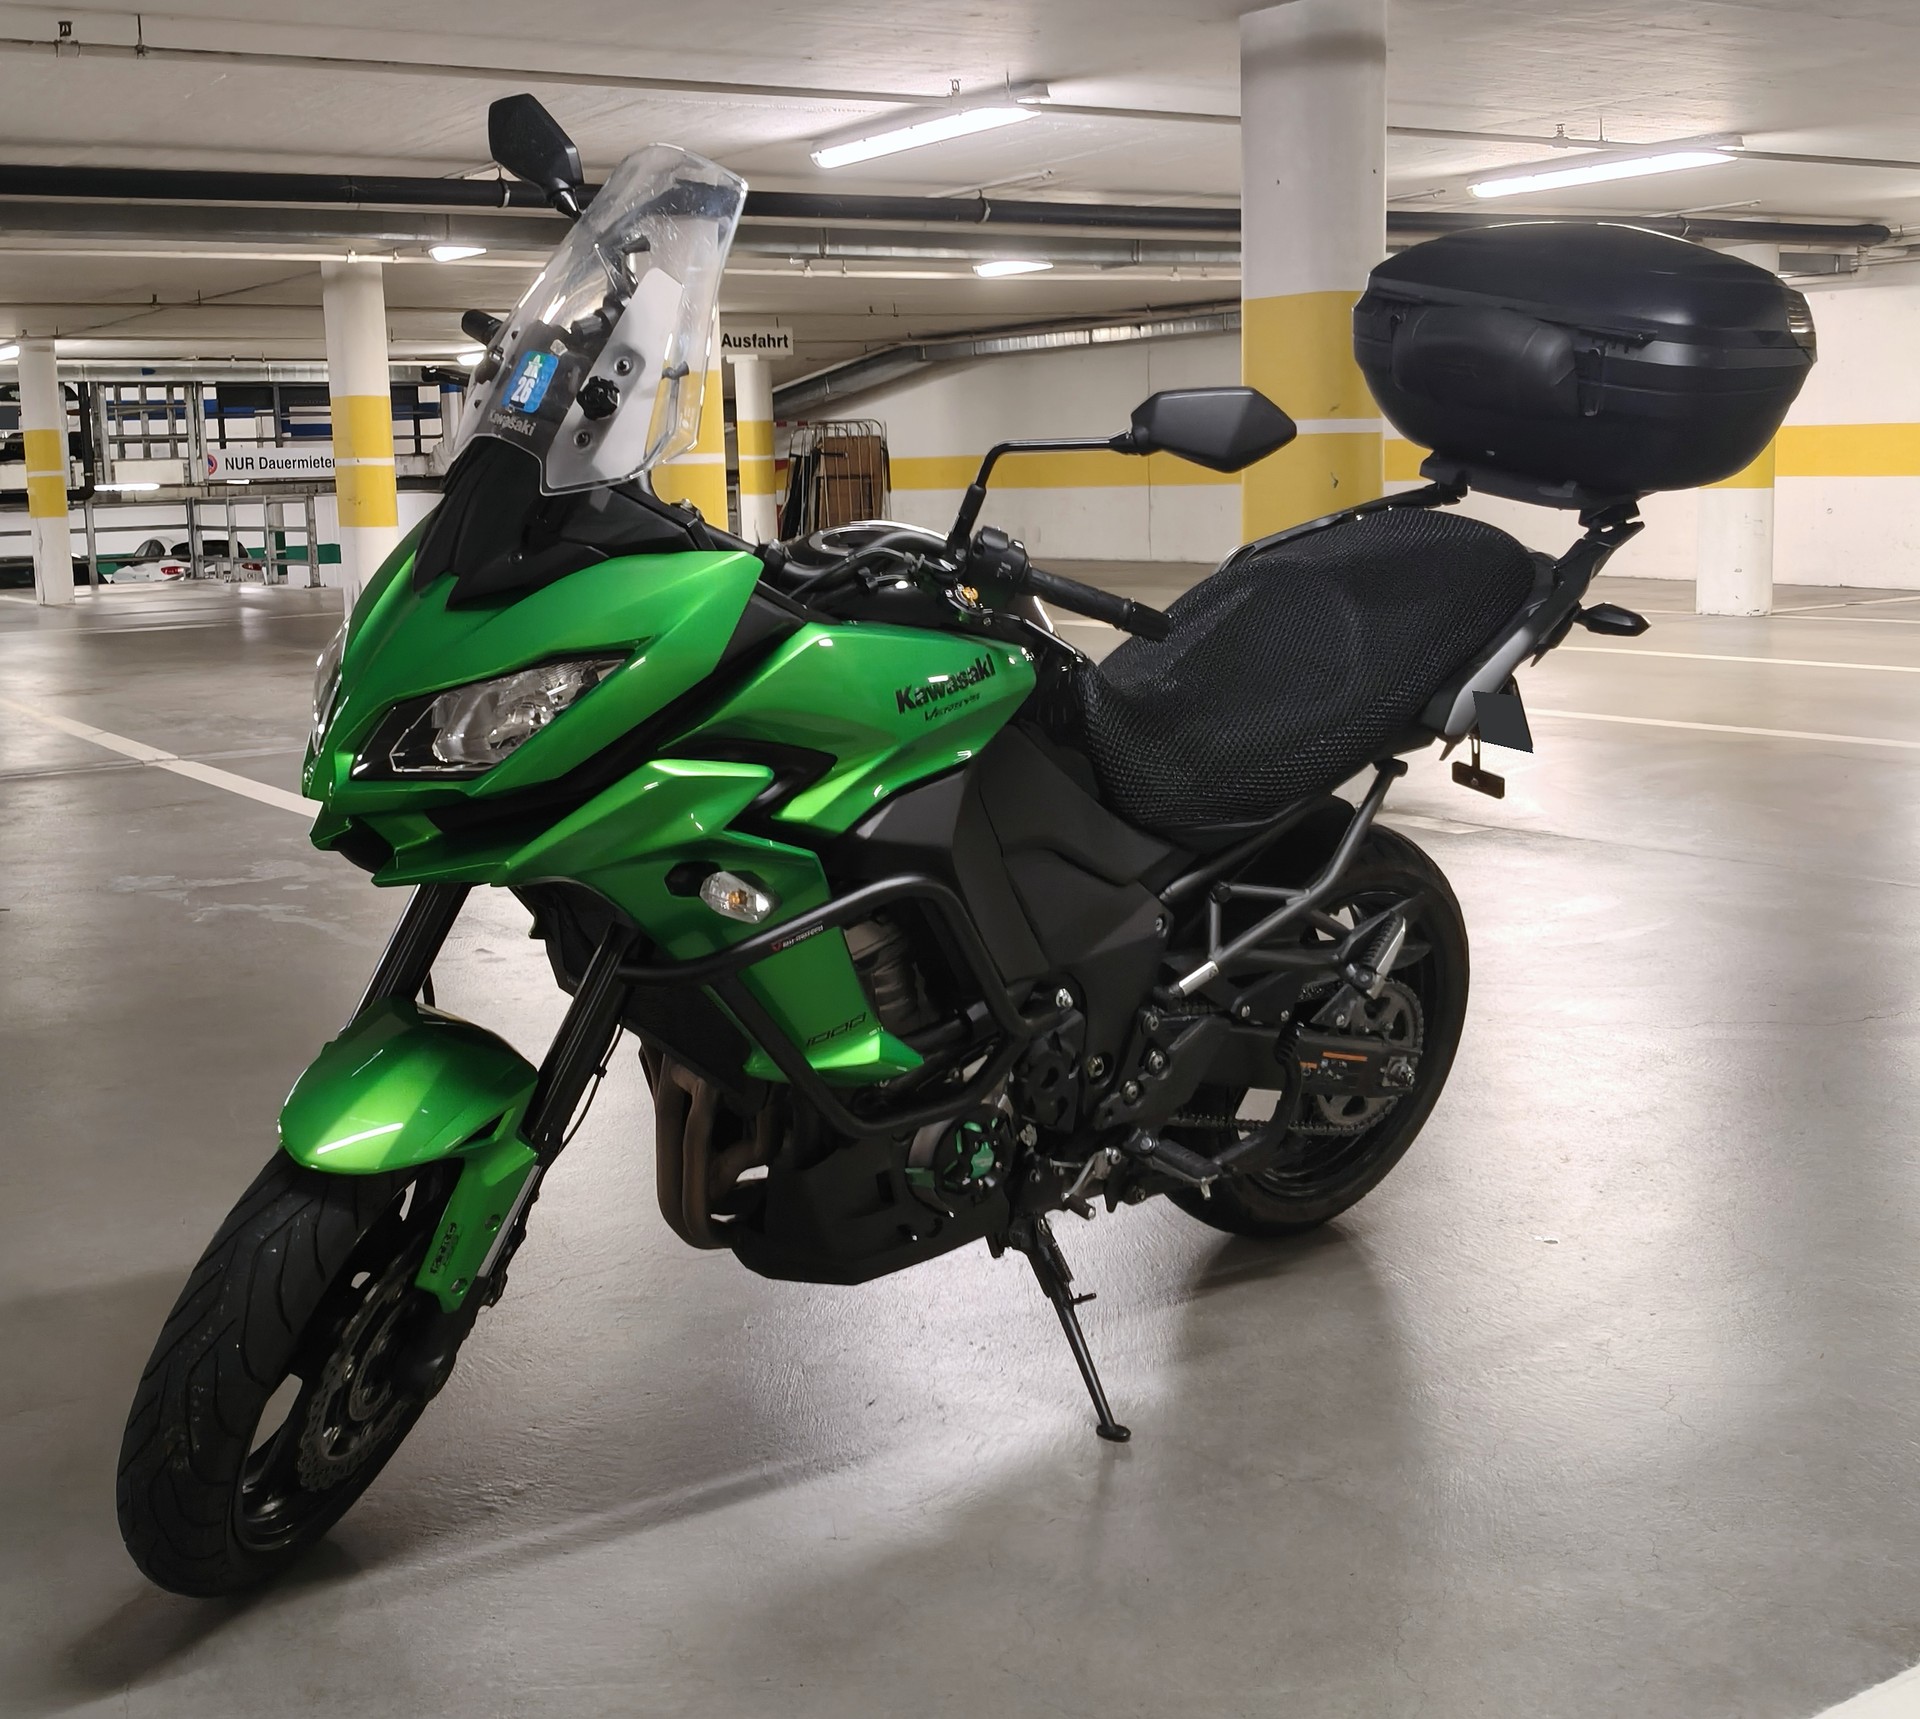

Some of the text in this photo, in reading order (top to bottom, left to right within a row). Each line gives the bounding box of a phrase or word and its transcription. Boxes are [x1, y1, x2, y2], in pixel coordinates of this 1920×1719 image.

[721, 333, 788, 348] Ausfahrt
[511, 377, 536, 403] 26
[225, 457, 255, 470] NUR
[895, 653, 996, 715] Kawasaki
